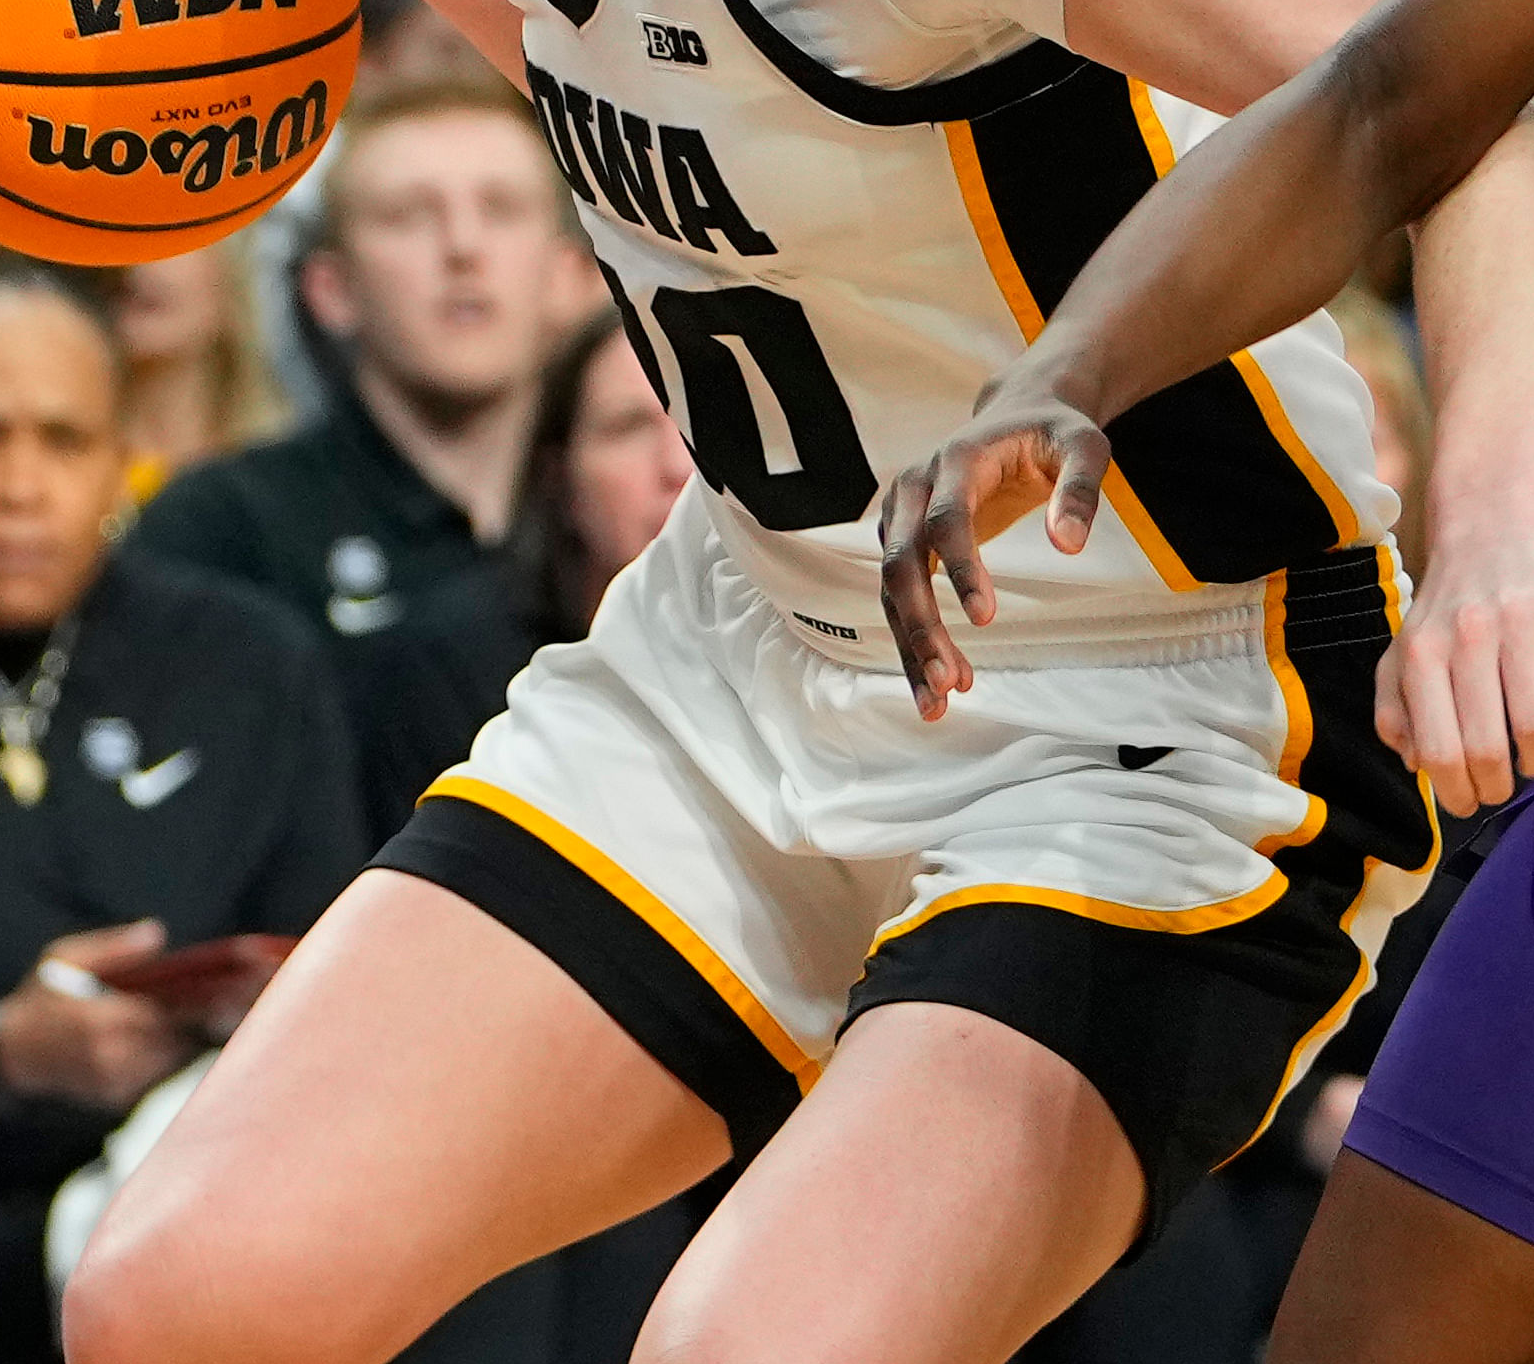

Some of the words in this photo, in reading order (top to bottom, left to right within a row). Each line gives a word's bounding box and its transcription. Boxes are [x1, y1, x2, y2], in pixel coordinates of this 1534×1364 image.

[26, 78, 327, 194] Wilson
[150, 108, 200, 124] NXT
[208, 94, 252, 118] EVO
[526, 62, 779, 257] OWA
[597, 256, 880, 532] 0
